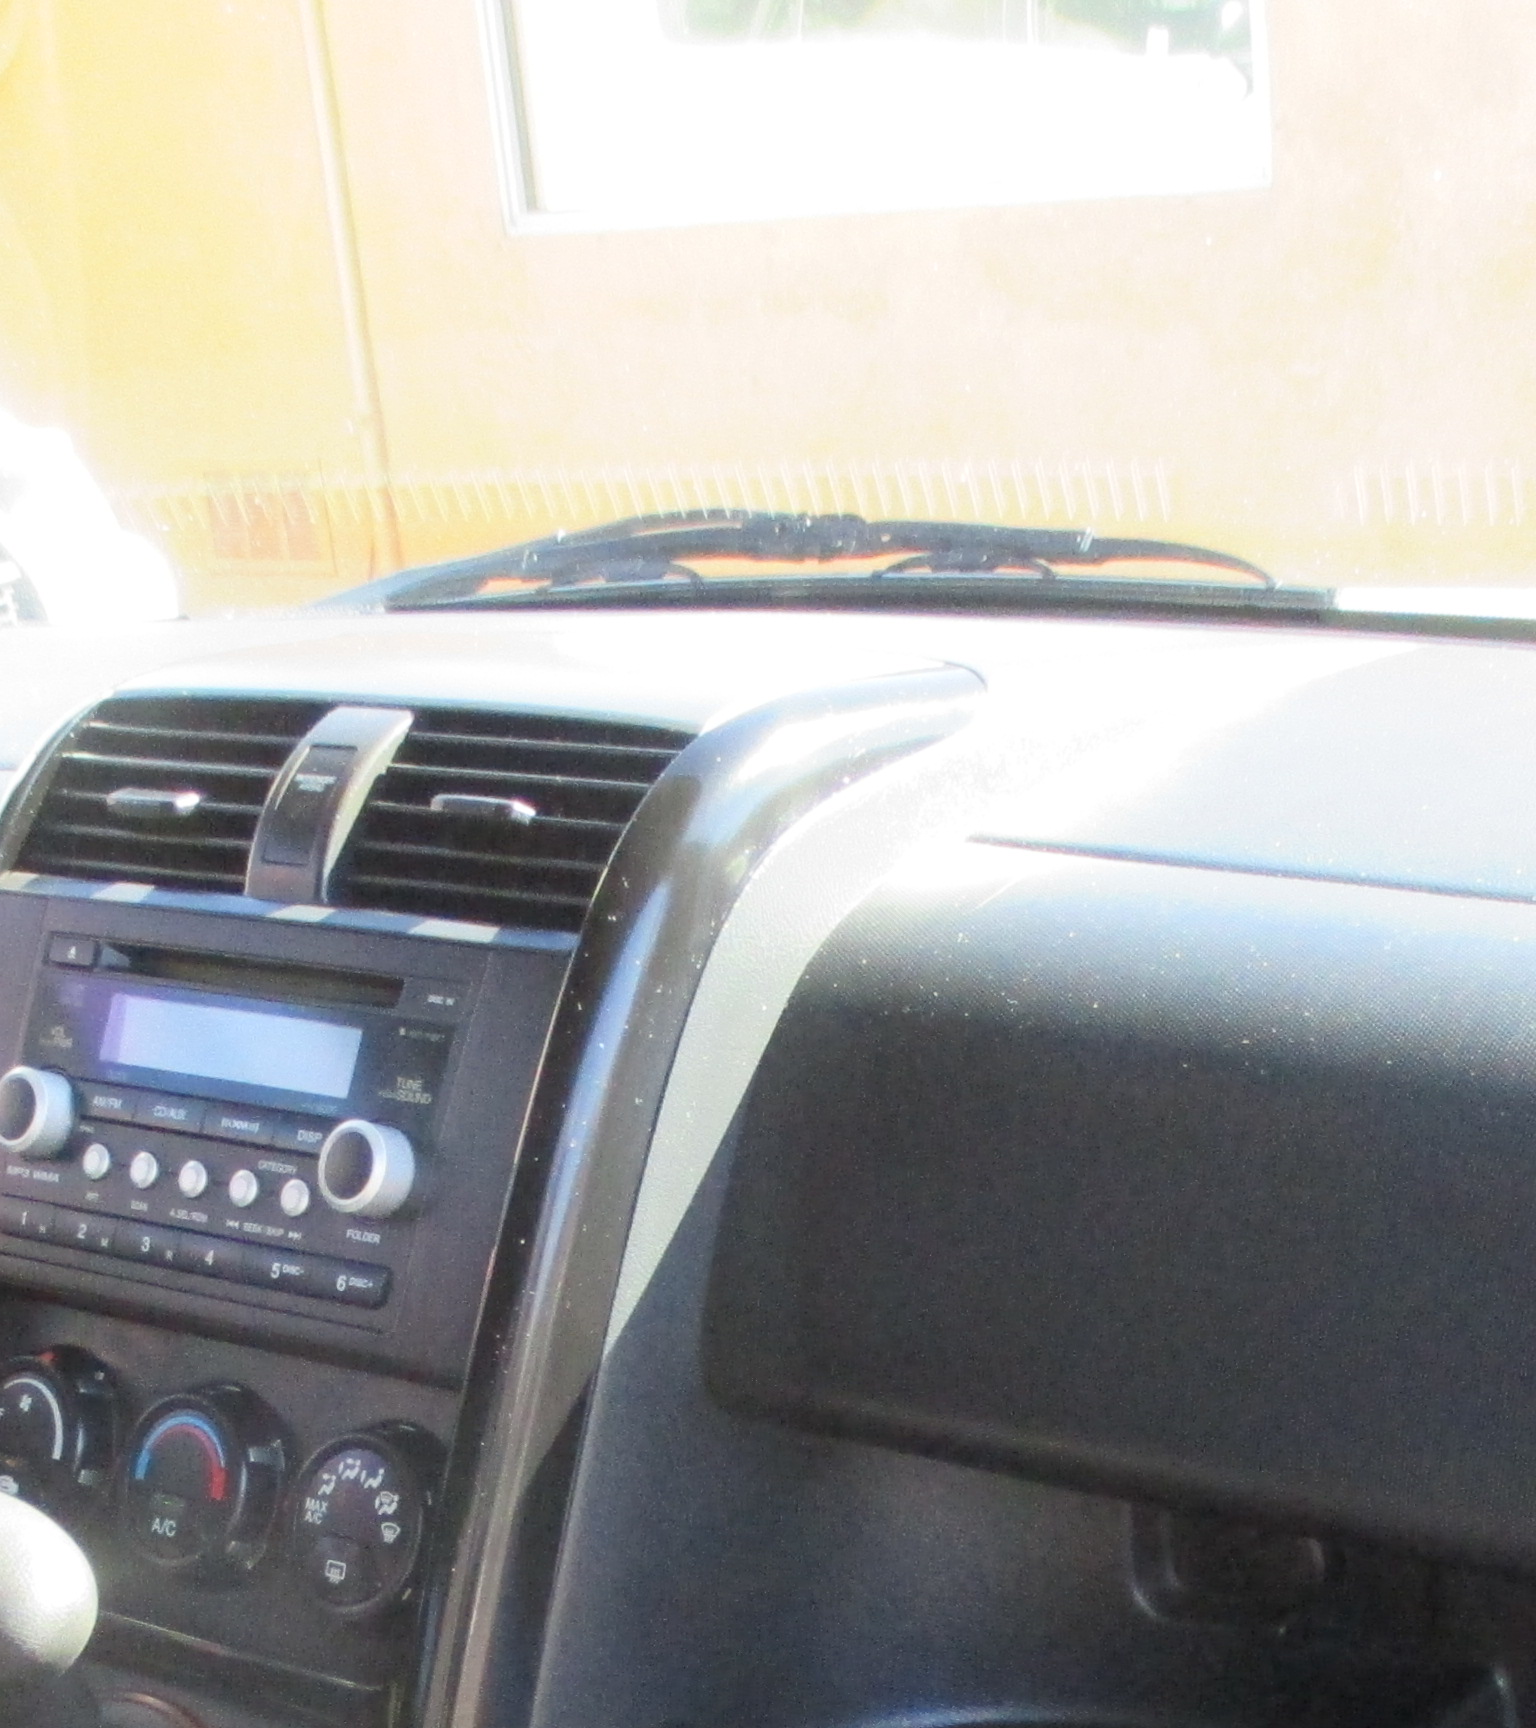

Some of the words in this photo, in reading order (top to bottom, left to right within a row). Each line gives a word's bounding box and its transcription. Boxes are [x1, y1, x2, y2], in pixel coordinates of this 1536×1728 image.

[296, 1129, 323, 1143] DISP
[6, 1165, 31, 1178] MP3
[257, 1160, 298, 1175] CATEGORY
[20, 1210, 28, 1226] 1
[77, 1223, 88, 1240] 2
[346, 1228, 381, 1244] FOLDER
[140, 1236, 151, 1252] 3
[204, 1250, 214, 1267] 4
[270, 1262, 281, 1279] 5
[336, 1274, 348, 1292] 6
[304, 1497, 329, 1513] MAX
[151, 1517, 177, 1537] A/C
